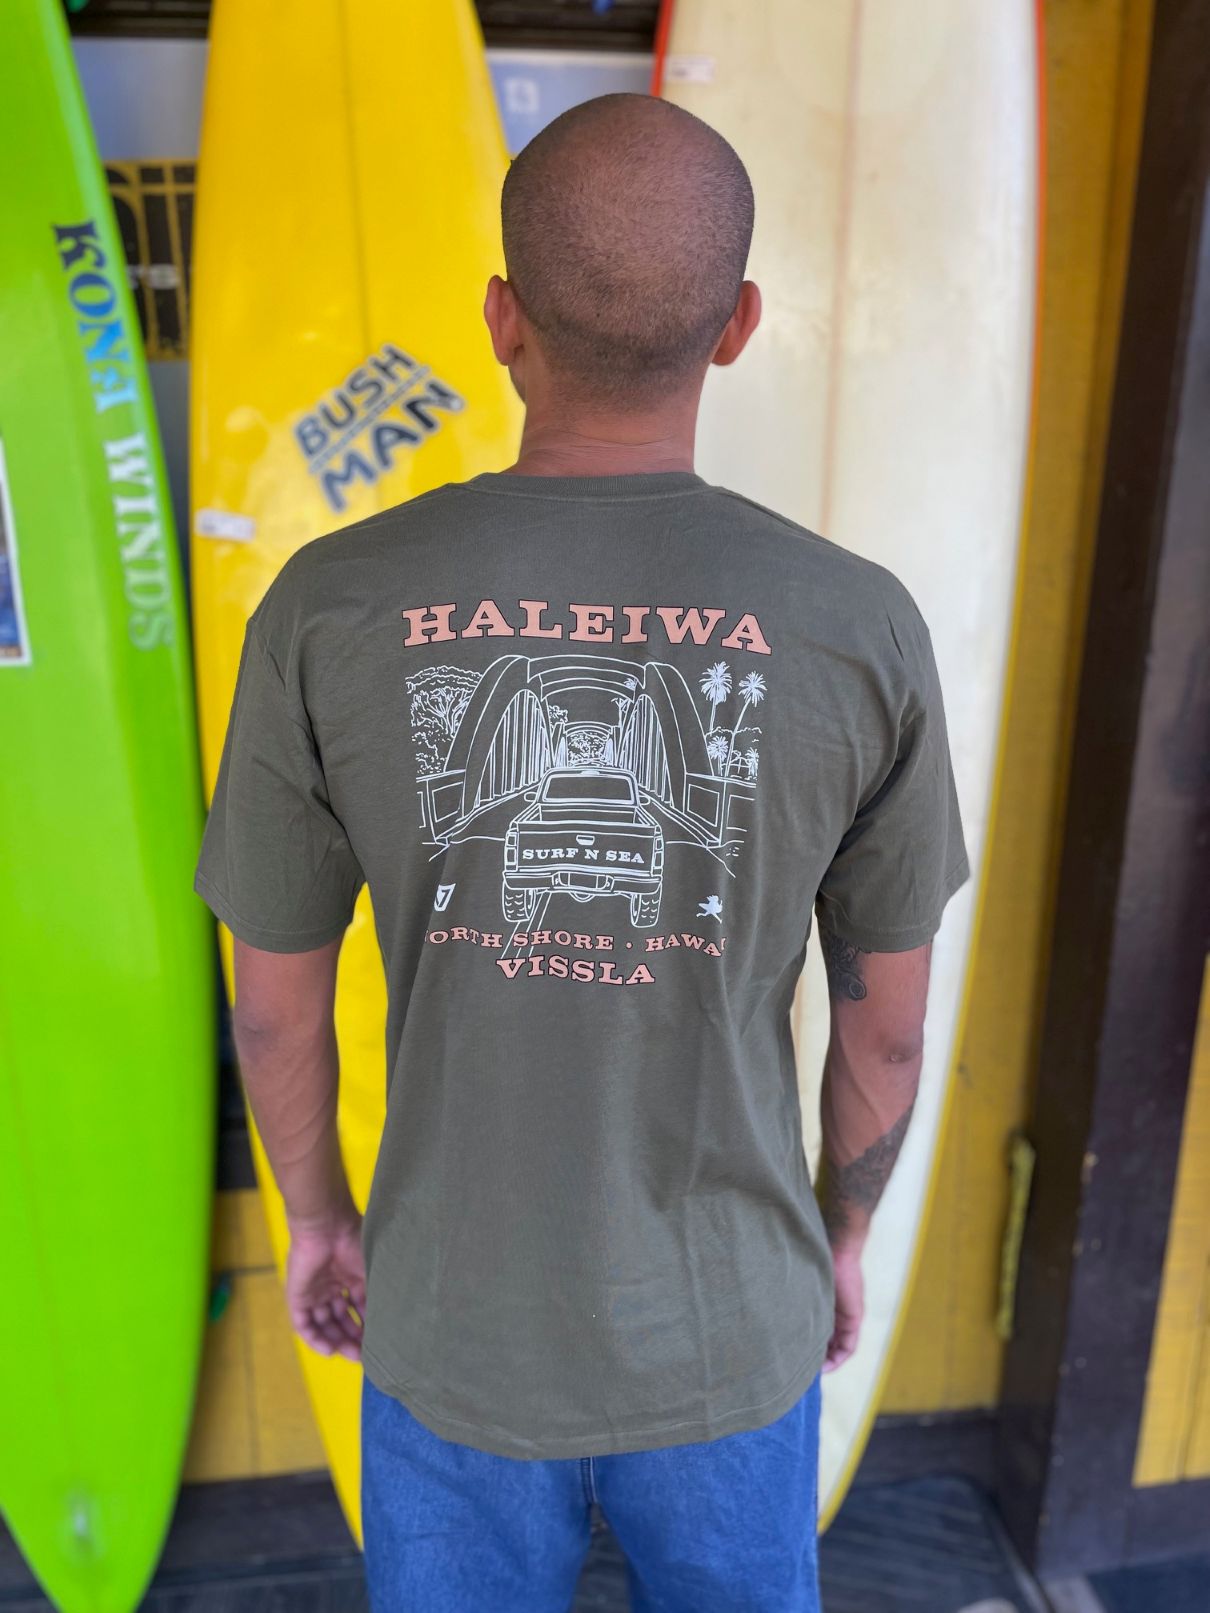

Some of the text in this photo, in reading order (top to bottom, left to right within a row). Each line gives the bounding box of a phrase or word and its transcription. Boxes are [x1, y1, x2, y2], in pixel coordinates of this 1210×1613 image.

[296, 344, 413, 456] BUSH
[53, 220, 174, 650] KONA WINDS
[322, 379, 463, 513] MAN
[402, 599, 773, 656] HALEIWA
[522, 847, 644, 864] SURF N SEA
[425, 926, 503, 948] ORTH
[513, 930, 614, 950] SHORE
[496, 955, 655, 985] VISSLA
